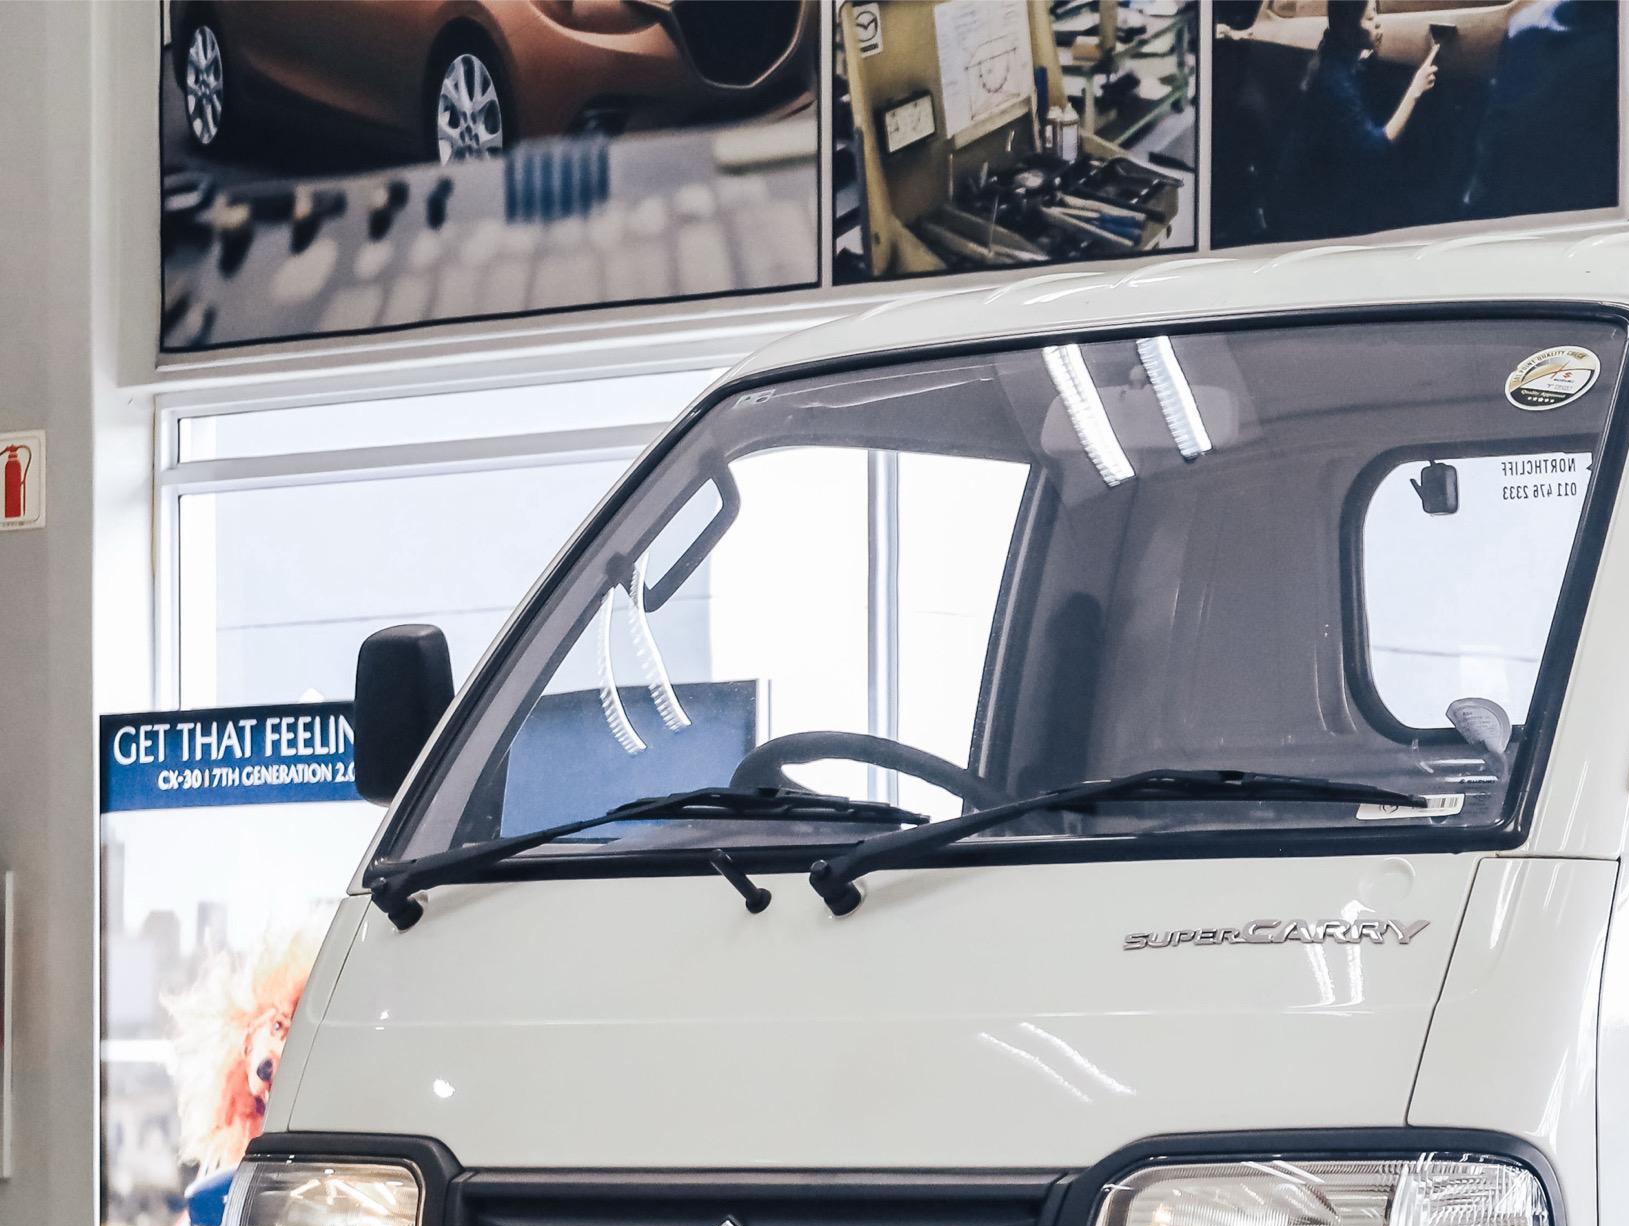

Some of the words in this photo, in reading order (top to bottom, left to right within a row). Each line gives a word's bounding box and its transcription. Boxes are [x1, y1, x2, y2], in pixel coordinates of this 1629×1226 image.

[113, 724, 170, 765] GET
[176, 718, 257, 761] THAT
[157, 769, 201, 790] CX-30
[212, 766, 239, 786] 7TH
[241, 763, 332, 785] GENERATION
